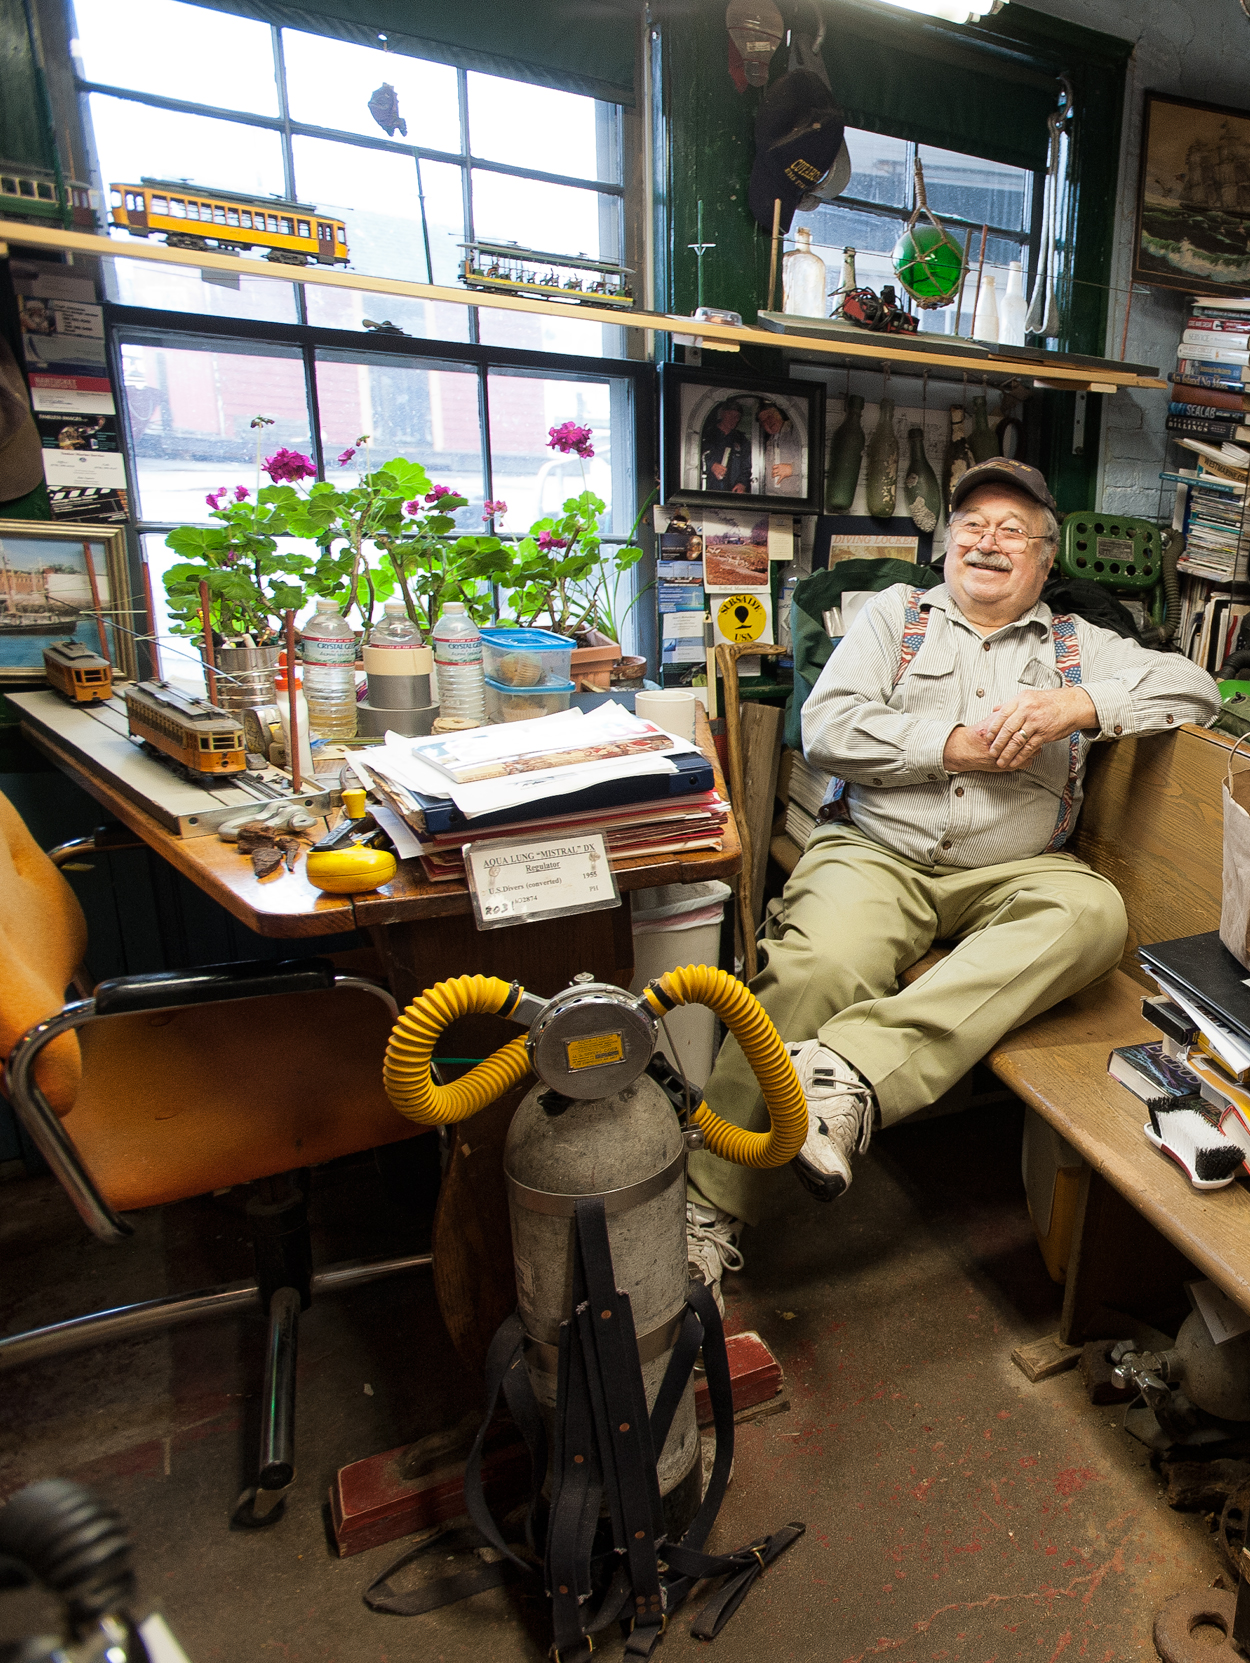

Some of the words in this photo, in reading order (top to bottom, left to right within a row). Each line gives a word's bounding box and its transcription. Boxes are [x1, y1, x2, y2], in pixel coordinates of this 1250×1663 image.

[1186, 404, 1216, 418] SEALAB
[1168, 422, 1208, 432] BILLINGS
[833, 536, 872, 544] DIVING
[874, 536, 918, 545] LOCKER
[734, 632, 753, 642] USA
[484, 858, 508, 867] AQUA
[511, 852, 534, 862] LUNG
[584, 844, 595, 852] DX
[526, 861, 560, 872] Regulator
[526, 878, 562, 890] (converted)
